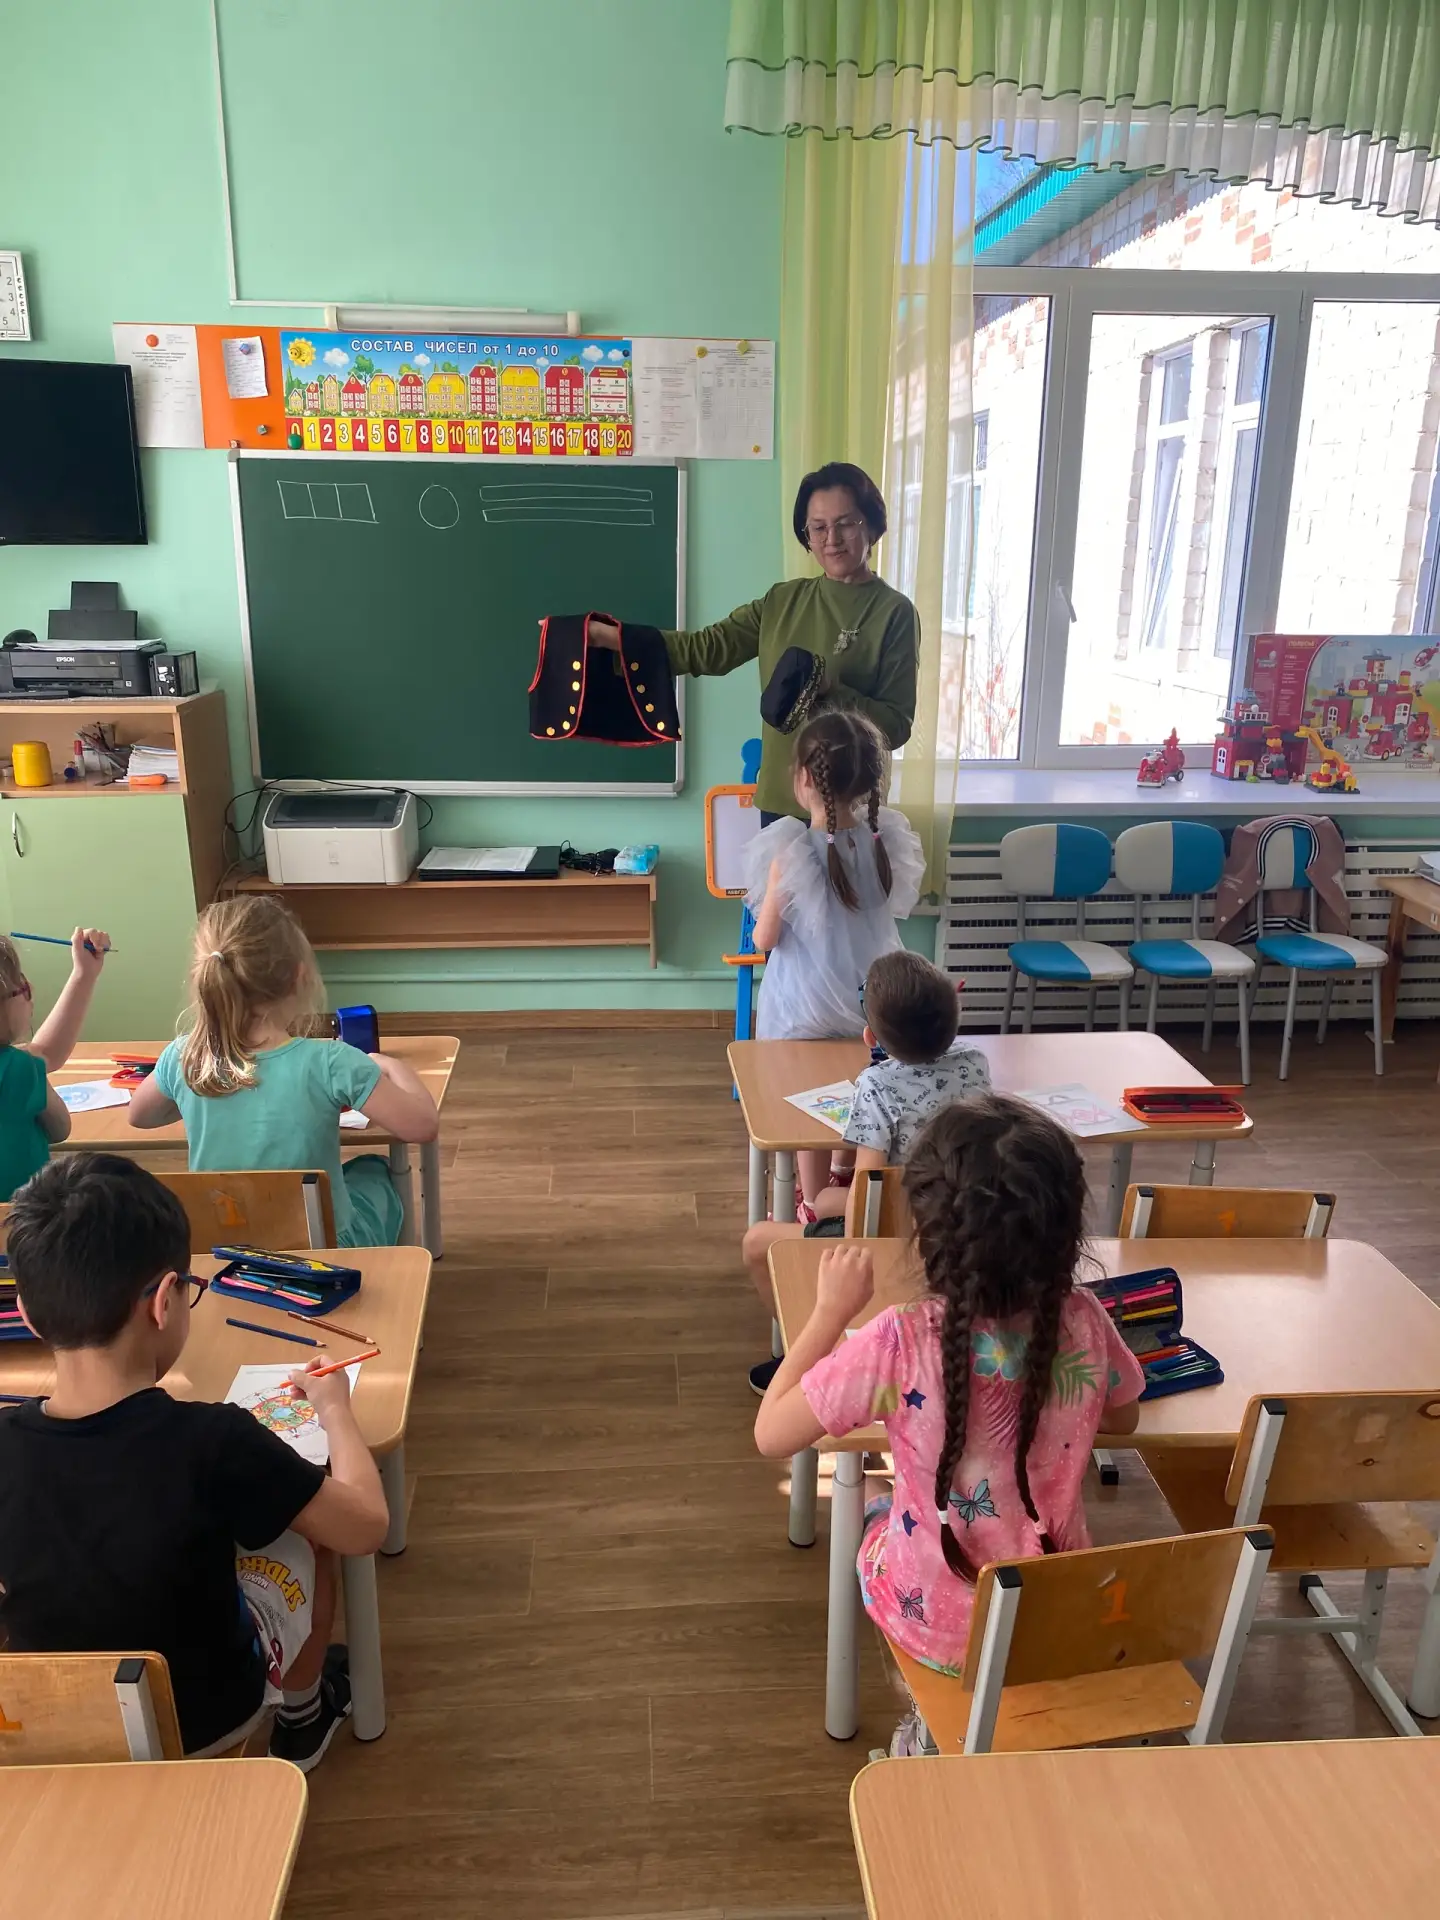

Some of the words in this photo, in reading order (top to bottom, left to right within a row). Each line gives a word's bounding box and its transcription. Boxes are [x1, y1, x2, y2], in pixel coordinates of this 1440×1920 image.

[6, 276, 12, 285] 2
[8, 292, 14, 301] 3
[10, 307, 16, 316] 4
[2, 316, 8, 325] 5
[351, 339, 415, 352] СОСТАВ
[424, 341, 478, 354] ЧИСЕЛ
[483, 345, 500, 356] от
[505, 343, 512, 355] 1
[517, 345, 537, 357] до
[542, 344, 559, 356] 10
[307, 423, 316, 443] 1
[323, 424, 333, 443] 2
[339, 424, 349, 444] 3
[355, 424, 365, 444] 4
[372, 424, 382, 444] 5
[387, 424, 398, 444] 6
[403, 425, 413, 444] 7
[419, 424, 430, 445] 8
[435, 425, 445, 445] 9
[449, 426, 464, 445] 10
[466, 426, 480, 446] 11
[483, 426, 498, 446] 12
[500, 426, 515, 447] 13
[516, 427, 532, 447] 14
[533, 427, 548, 447] 15
[550, 428, 565, 447] 16
[567, 428, 582, 448] 17
[584, 428, 599, 448] 18
[601, 428, 616, 449] 19
[617, 429, 632, 449] 20
[215, 1194, 247, 1227] 1
[1100, 1579, 1132, 1625] 1
